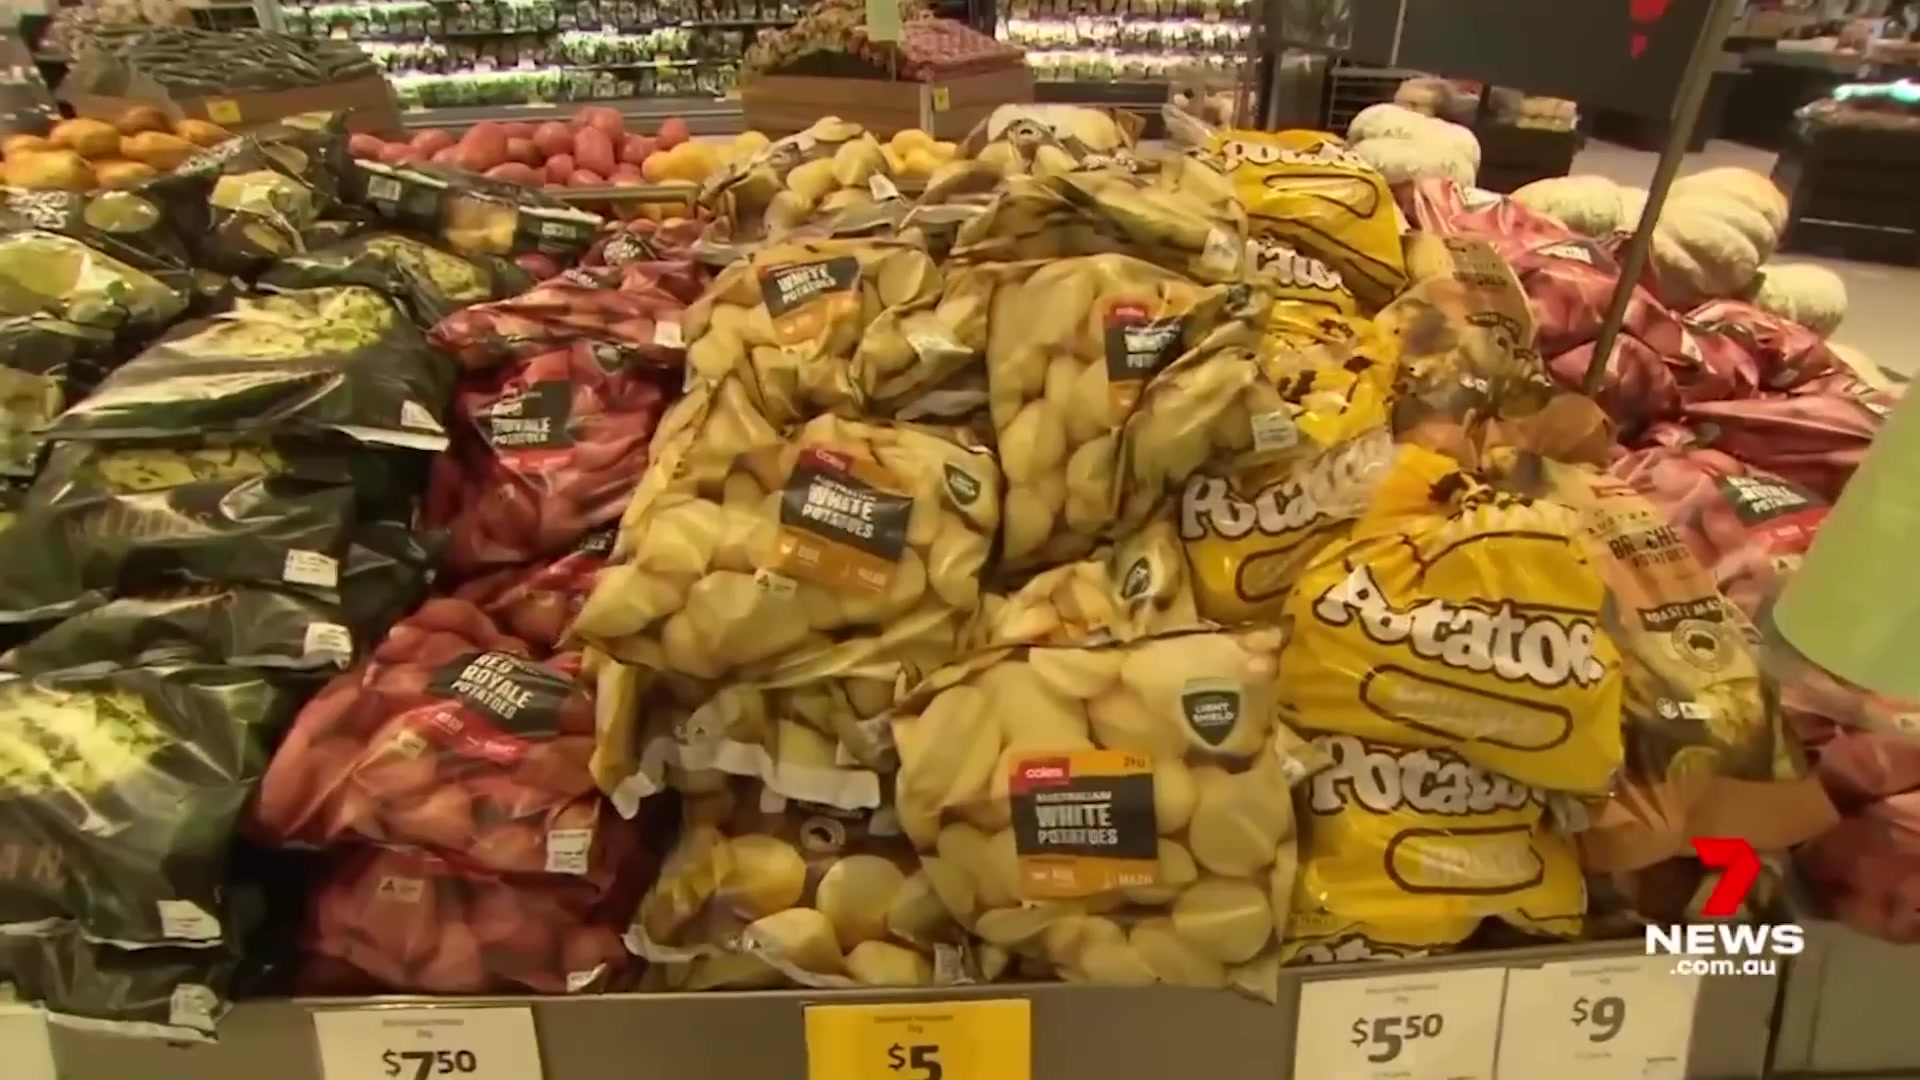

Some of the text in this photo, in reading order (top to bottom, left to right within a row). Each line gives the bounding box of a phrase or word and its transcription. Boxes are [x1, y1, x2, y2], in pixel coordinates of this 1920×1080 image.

[807, 483, 876, 521] WHITE
[450, 680, 518, 720] POTATOES
[459, 664, 535, 709] ROYALE
[1035, 802, 1113, 827] WHITE
[1570, 995, 1626, 1043] $9
[887, 1043, 943, 1080] $5
